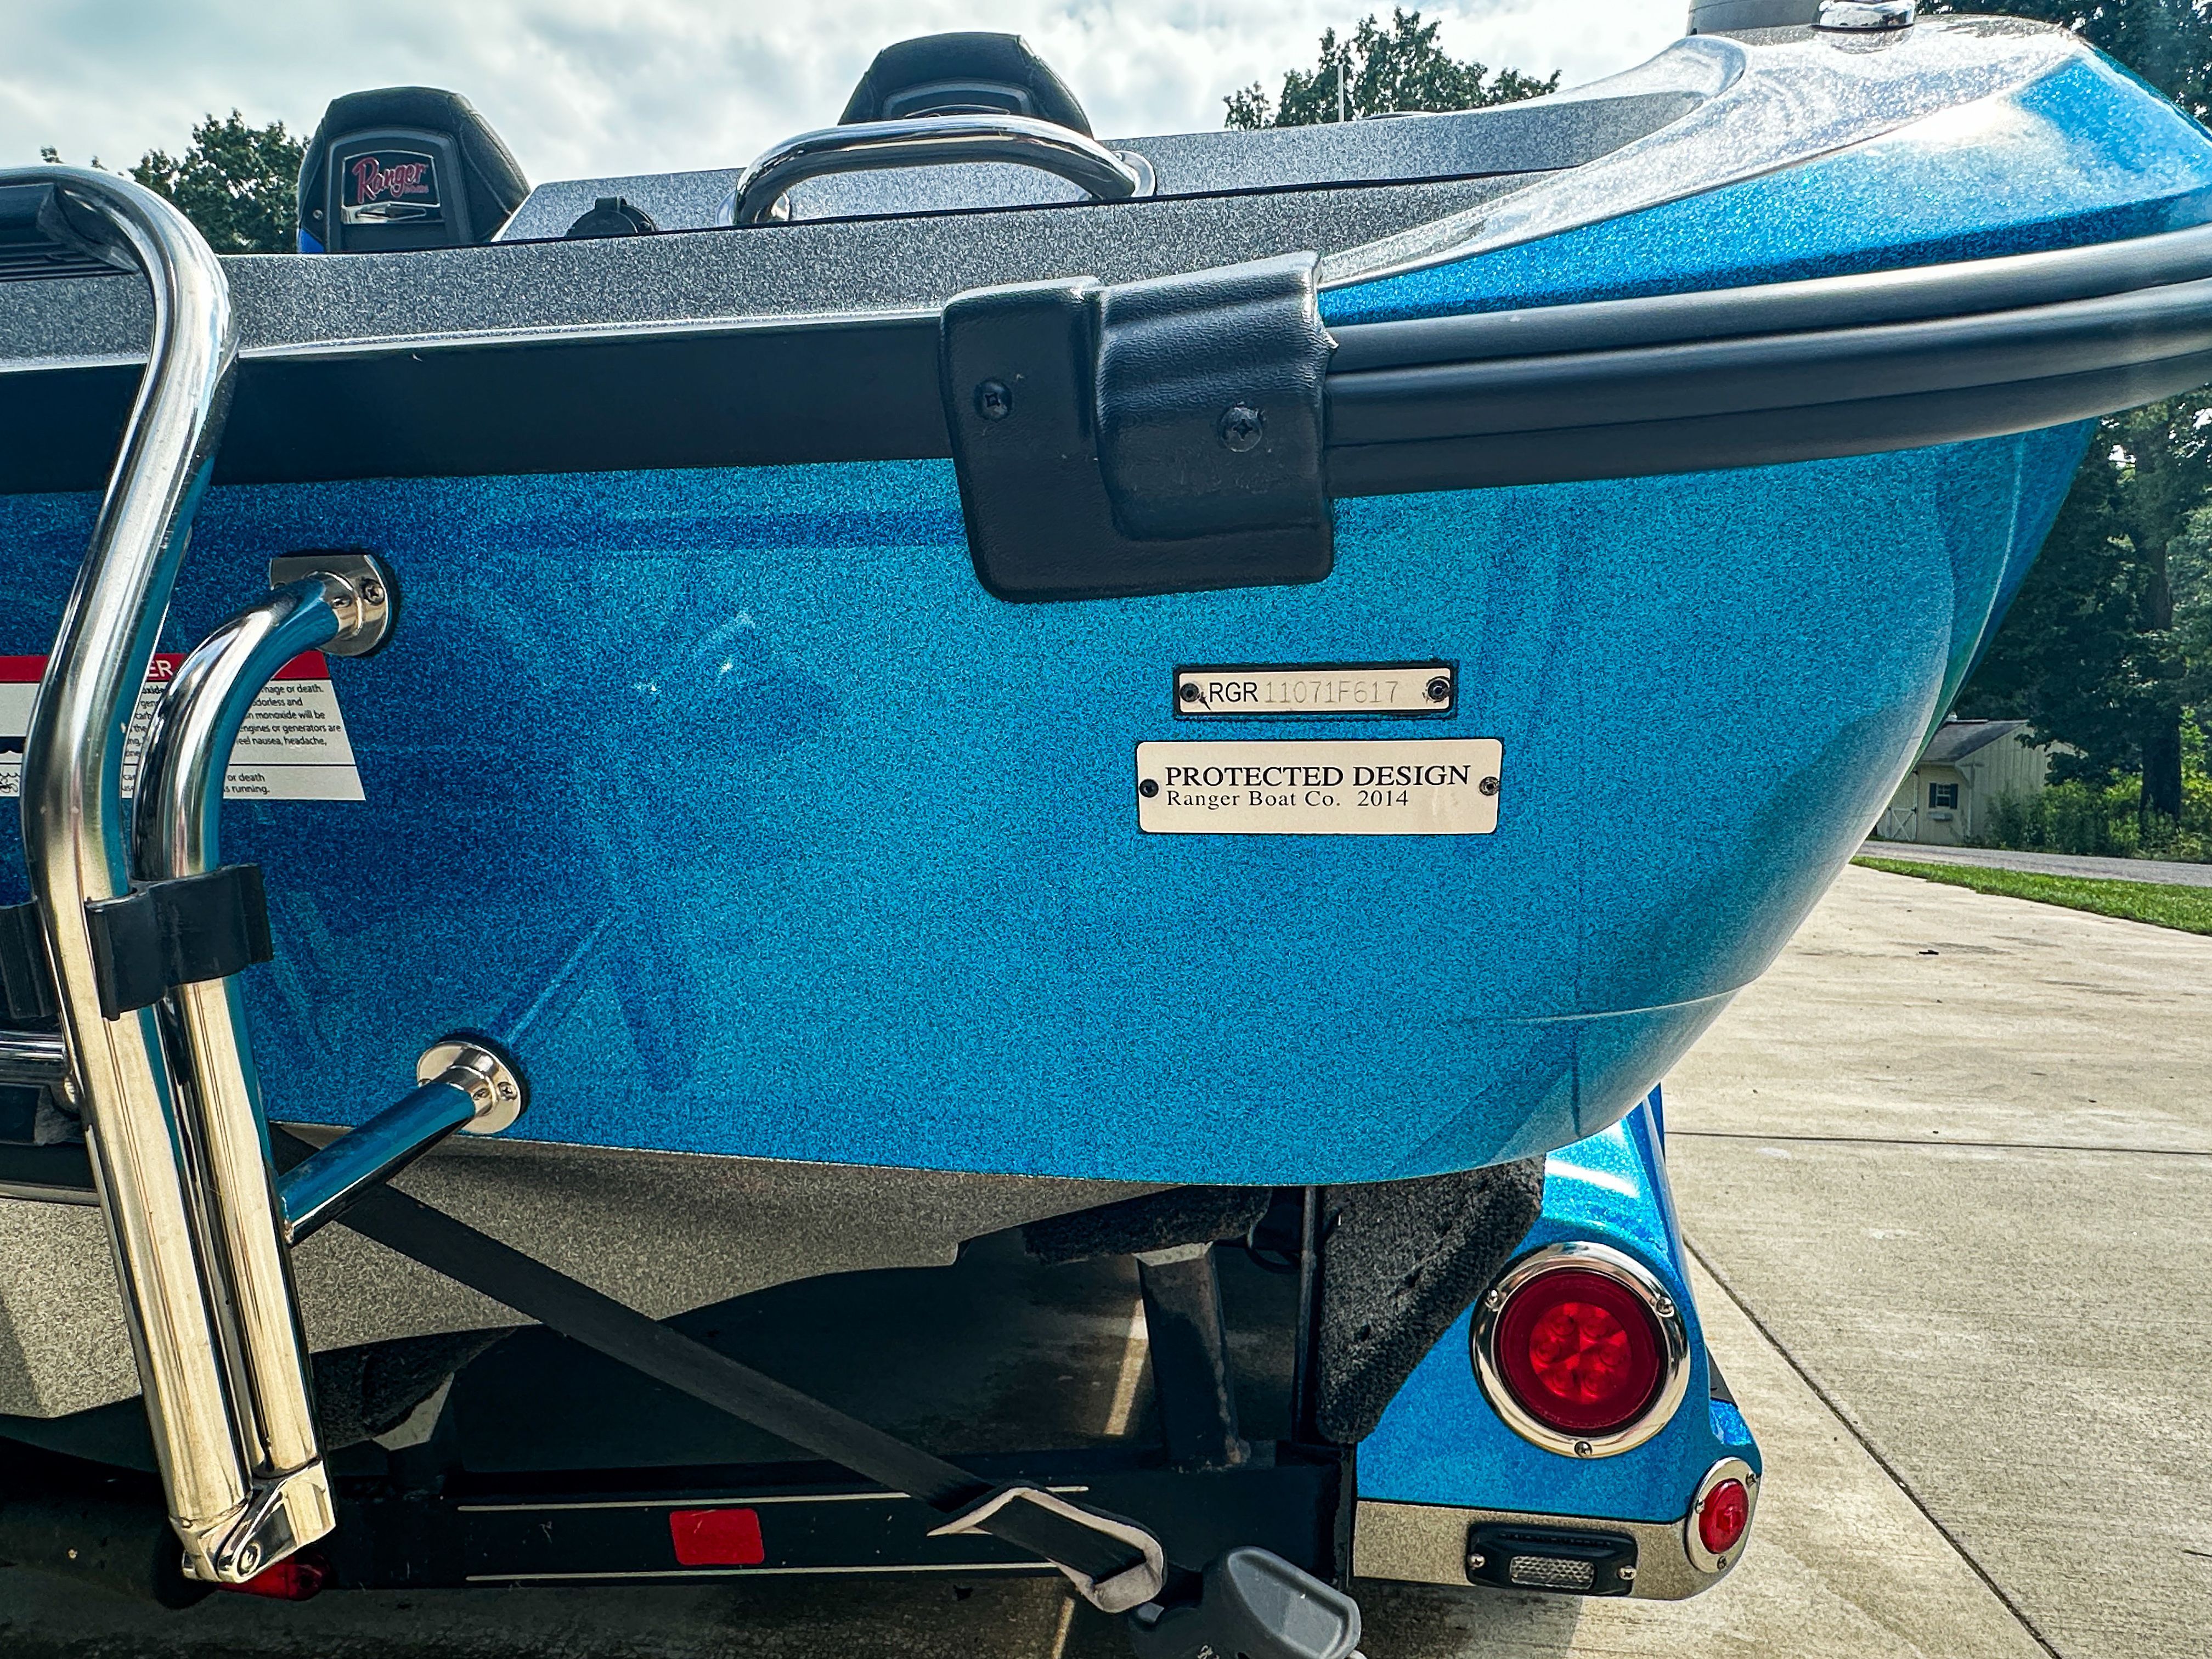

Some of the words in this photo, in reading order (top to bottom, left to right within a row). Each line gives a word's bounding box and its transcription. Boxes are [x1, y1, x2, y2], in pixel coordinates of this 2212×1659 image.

[352, 157, 427, 204] Ranger
[296, 684, 324, 693] death.
[1209, 681, 1259, 703] RGR
[1265, 680, 1398, 703] 11071F617
[287, 697, 303, 706] and
[255, 710, 297, 719] monoxide
[298, 710, 313, 719] will
[314, 710, 325, 719] be
[283, 724, 327, 734] generators
[284, 736, 326, 746] headache,
[238, 772, 266, 781] death
[1165, 766, 1344, 786] PROTECTED
[1352, 765, 1471, 786] DESIGN
[230, 785, 270, 795] running.
[1167, 790, 1240, 810] Ranger
[1248, 791, 1297, 806] Boat
[1304, 791, 1341, 806] Co.
[1357, 789, 1409, 806] 2014
